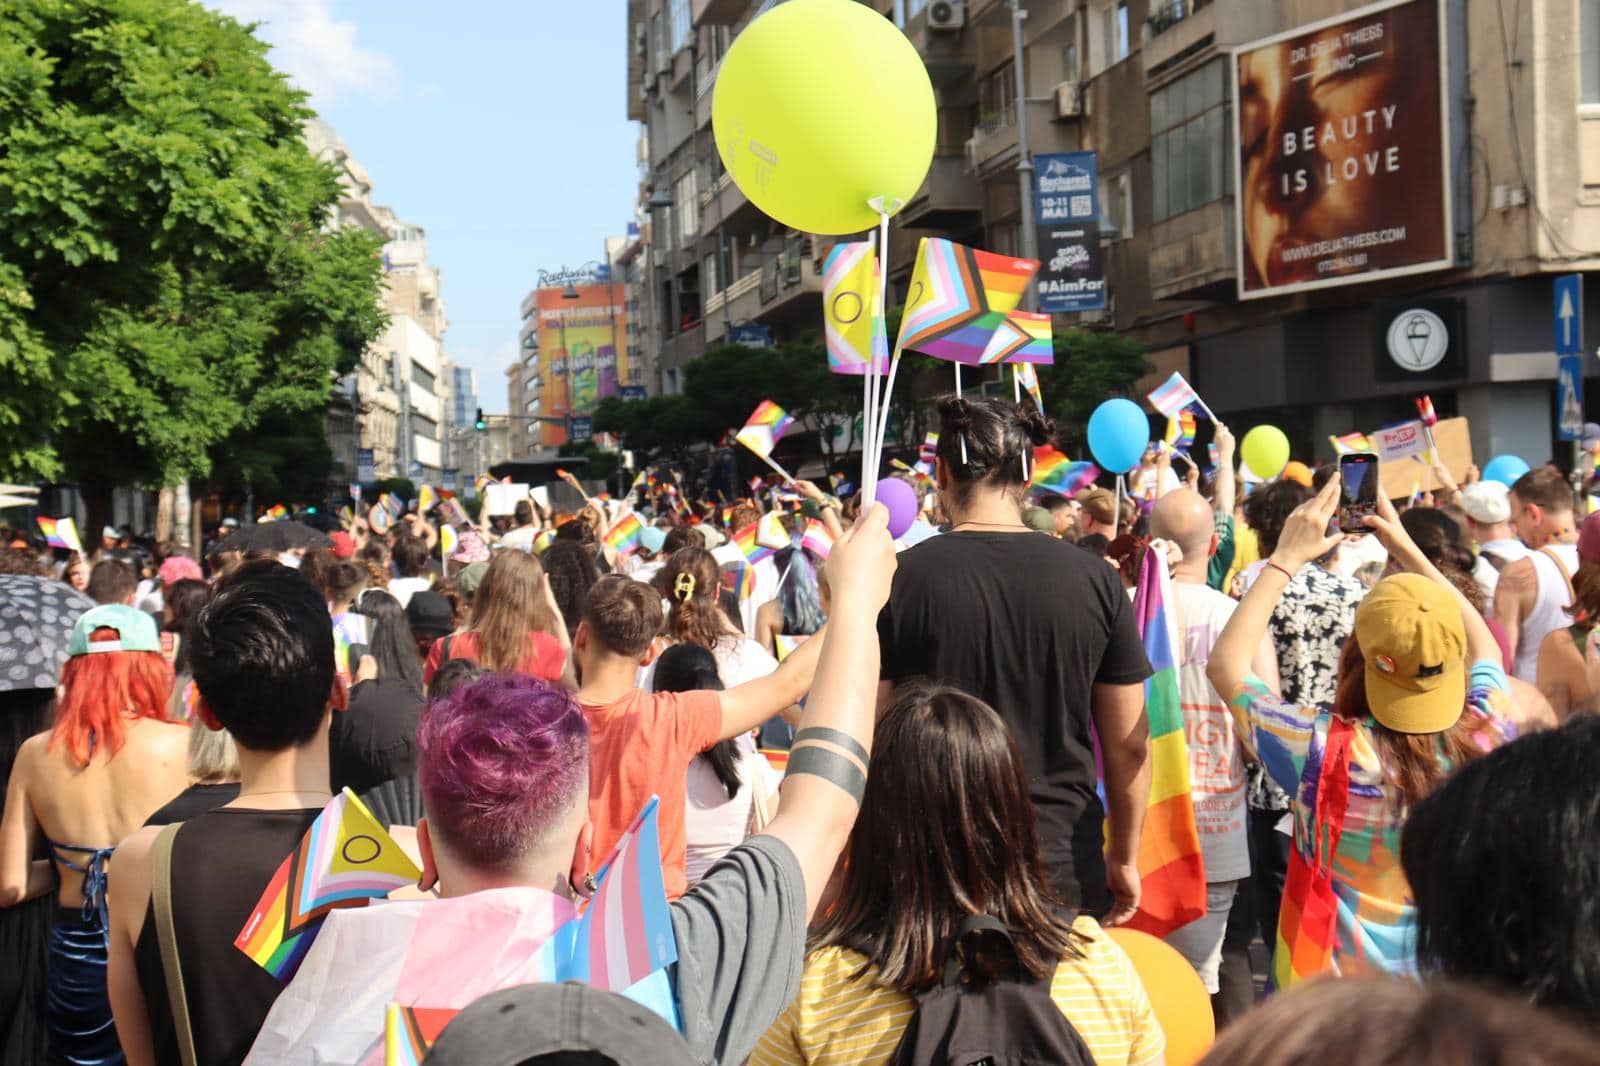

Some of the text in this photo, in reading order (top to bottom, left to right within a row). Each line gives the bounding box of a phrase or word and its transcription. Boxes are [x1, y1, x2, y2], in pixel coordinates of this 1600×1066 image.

[1343, 23, 1384, 48] THIESS
[1319, 53, 1356, 75] INIC
[1283, 104, 1397, 156] BEAUTY
[1281, 146, 1400, 195] IS LOVE
[1042, 207, 1068, 219] MAI
[1038, 278, 1104, 294] #AimFar
